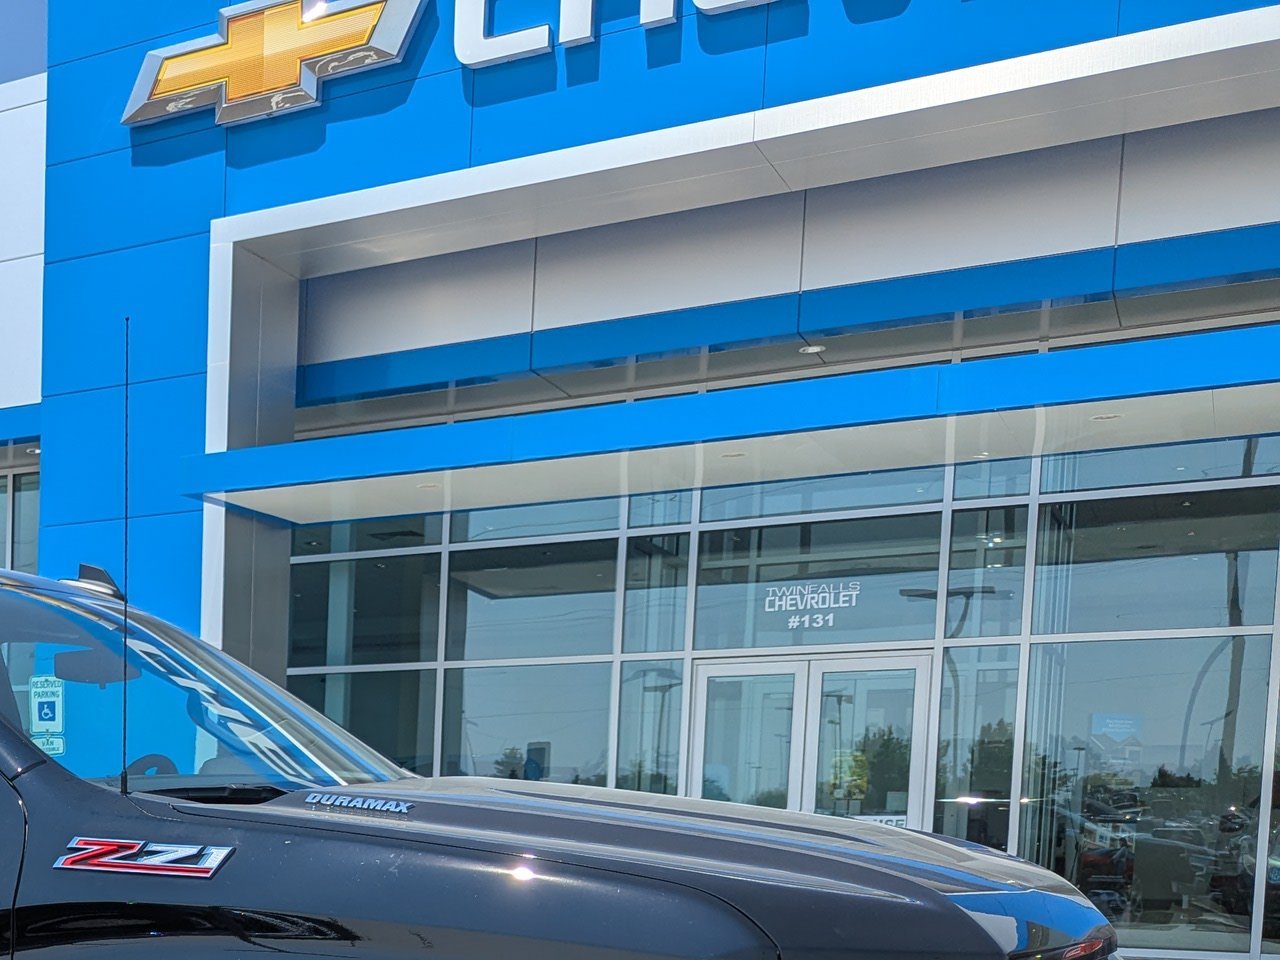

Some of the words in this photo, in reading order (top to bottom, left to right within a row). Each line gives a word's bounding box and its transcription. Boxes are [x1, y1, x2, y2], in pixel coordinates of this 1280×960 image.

[765, 592, 860, 612] CHEVROLET
[788, 613, 834, 629] #131
[32, 680, 62, 688] RESERVED
[33, 691, 60, 699] PARKING
[305, 793, 415, 813] DURAMAX
[53, 837, 236, 879] Z71
